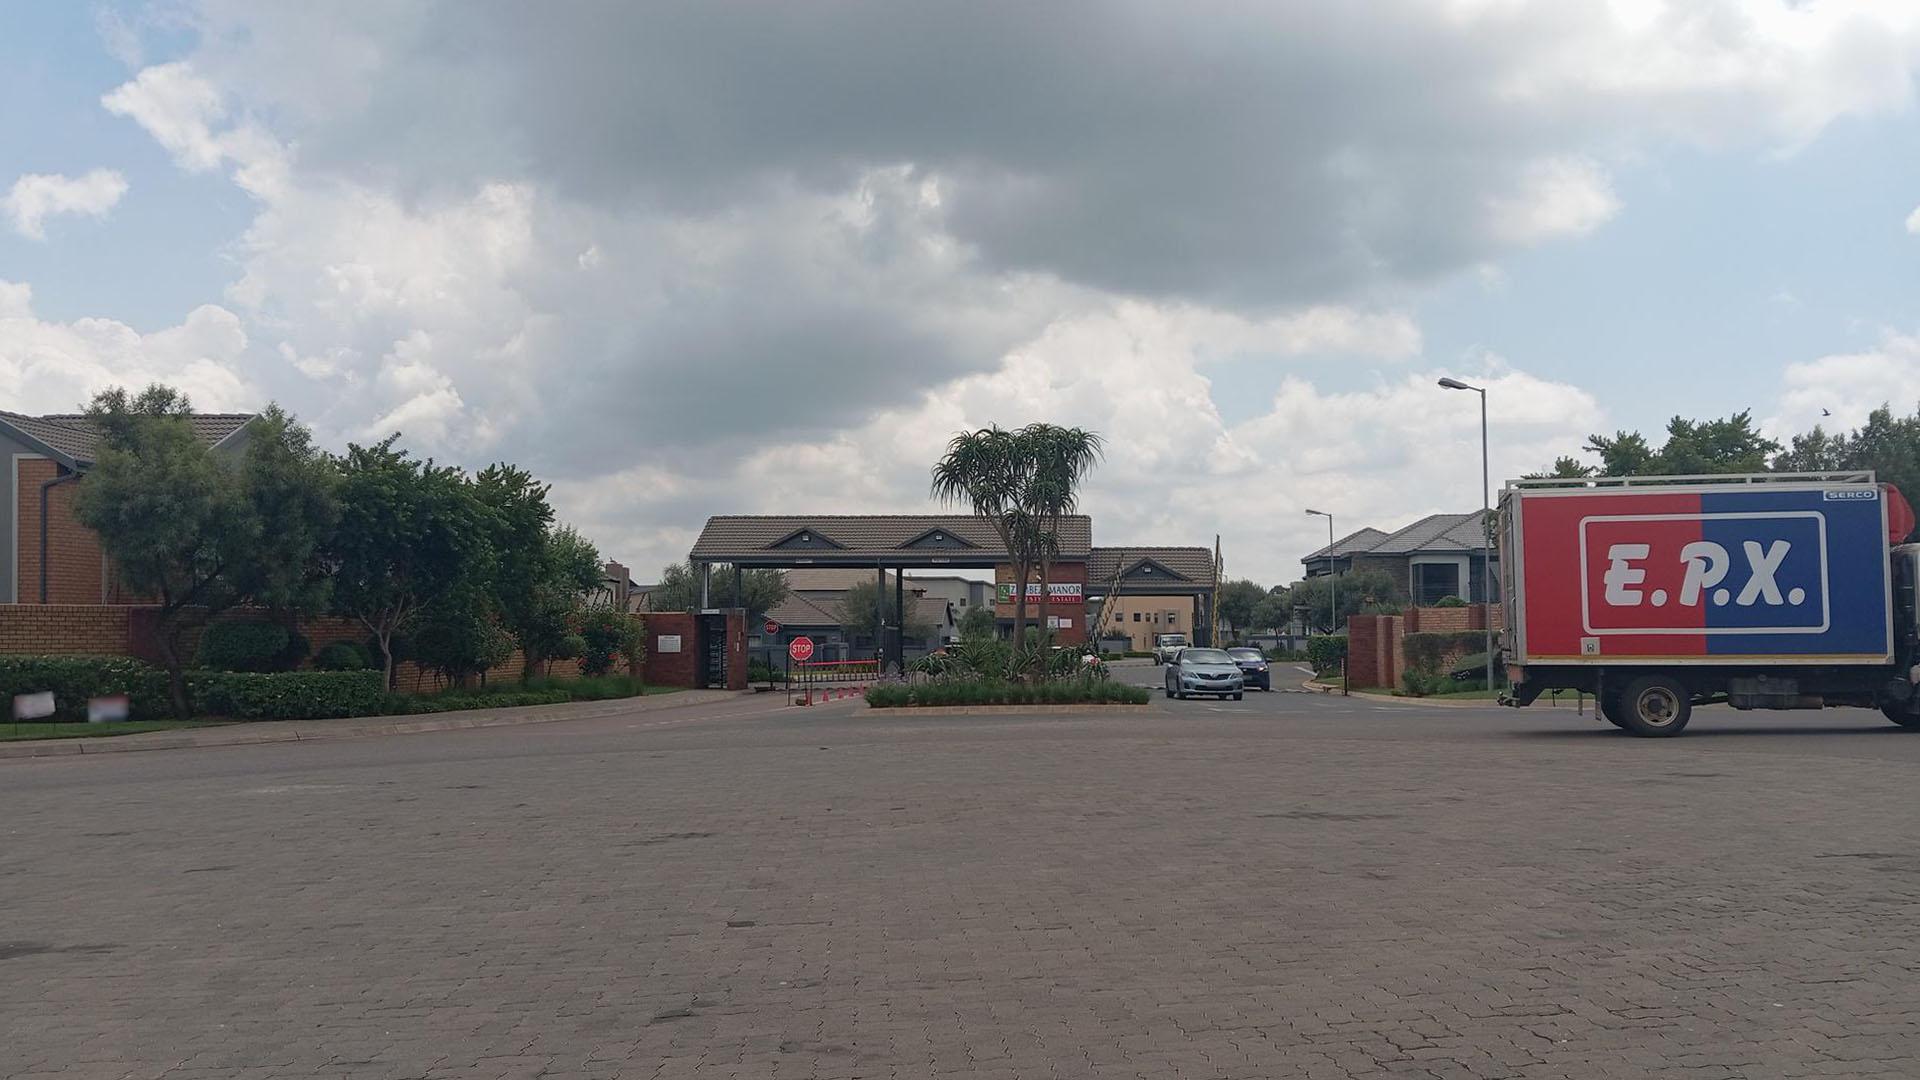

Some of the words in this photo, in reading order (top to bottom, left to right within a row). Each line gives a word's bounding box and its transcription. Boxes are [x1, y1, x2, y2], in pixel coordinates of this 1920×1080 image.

[1828, 491, 1873, 499] SERCO
[1604, 540, 1806, 607] E.P.X.
[1048, 585, 1081, 595] MANOR
[792, 644, 811, 654] STOP
